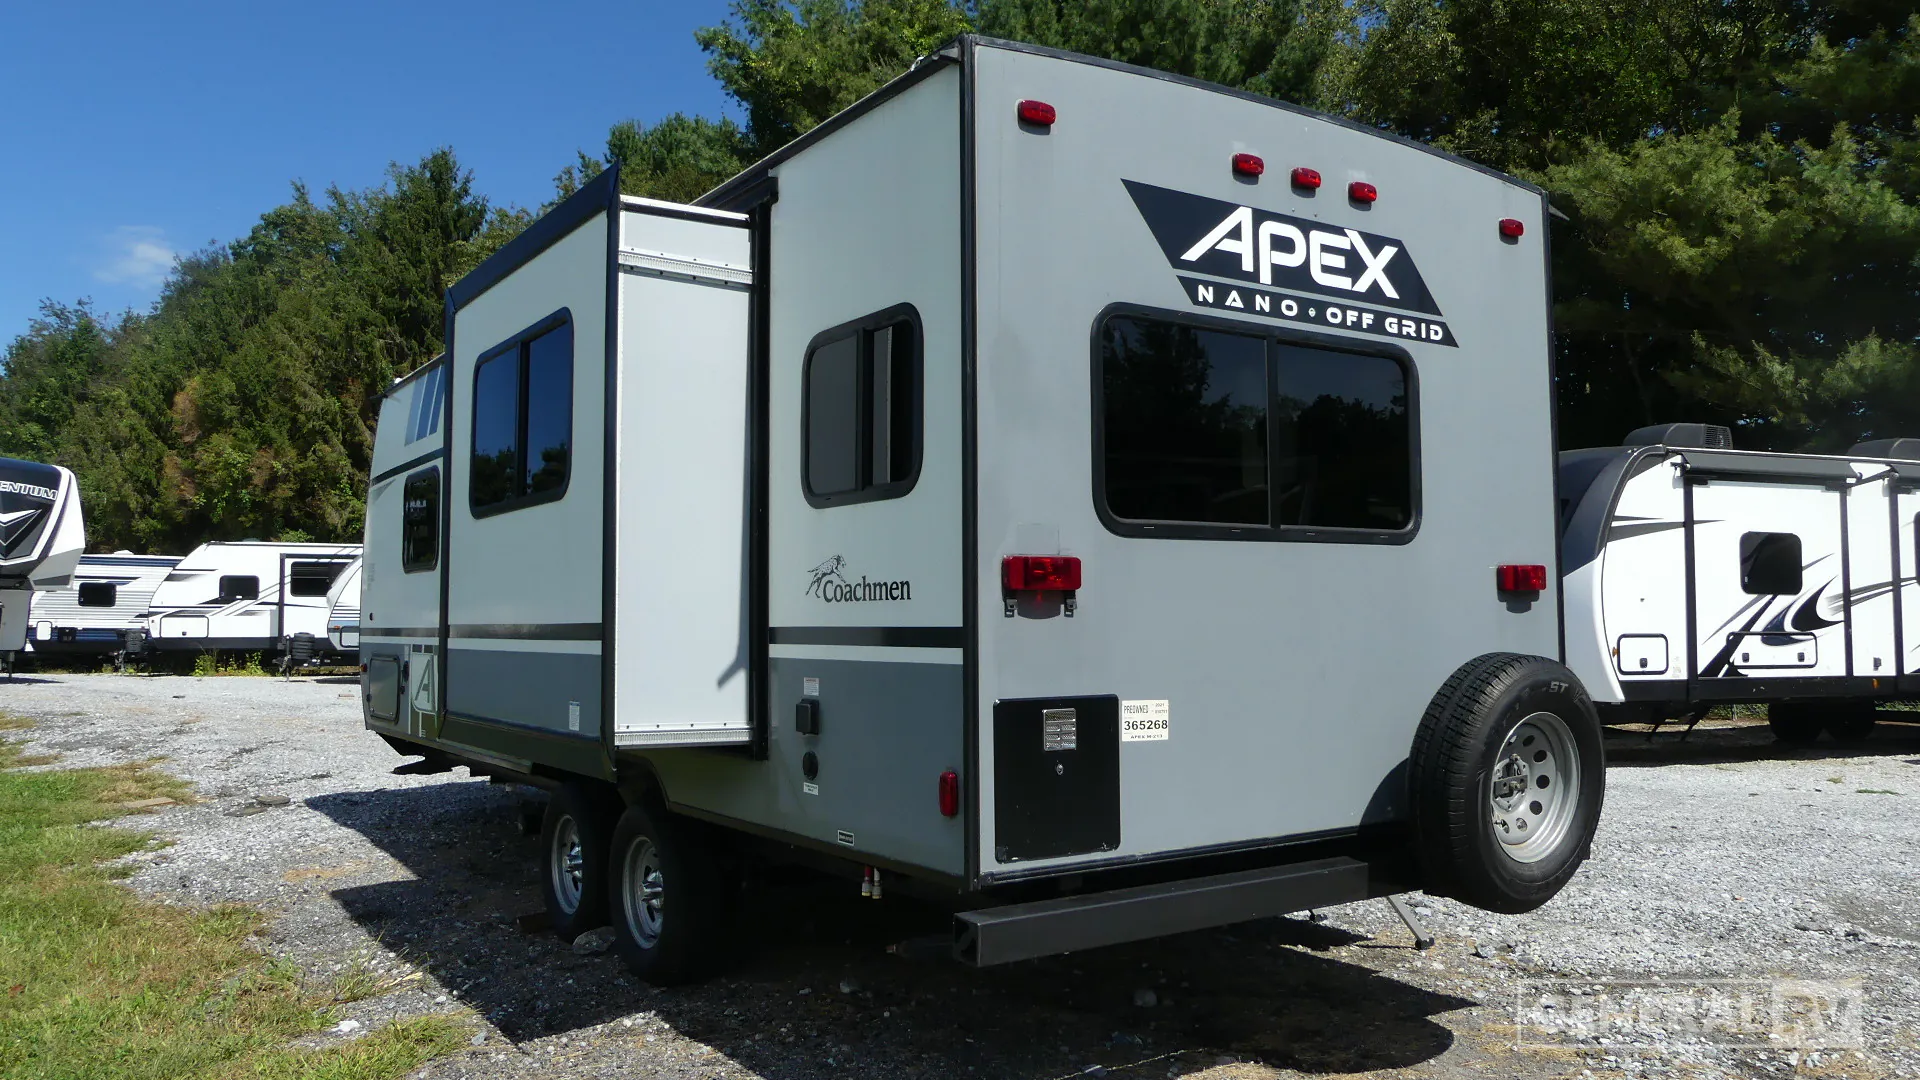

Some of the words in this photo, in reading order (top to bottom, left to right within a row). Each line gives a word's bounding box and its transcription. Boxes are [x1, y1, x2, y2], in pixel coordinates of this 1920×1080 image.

[1180, 206, 1400, 300] APEX
[1198, 284, 1298, 317] NANO
[1326, 307, 1375, 330] OFF
[1384, 319, 1444, 341] GRID
[823, 575, 911, 603] Coachmen
[1549, 681, 1569, 693] ST
[1124, 720, 1168, 730] 365268
